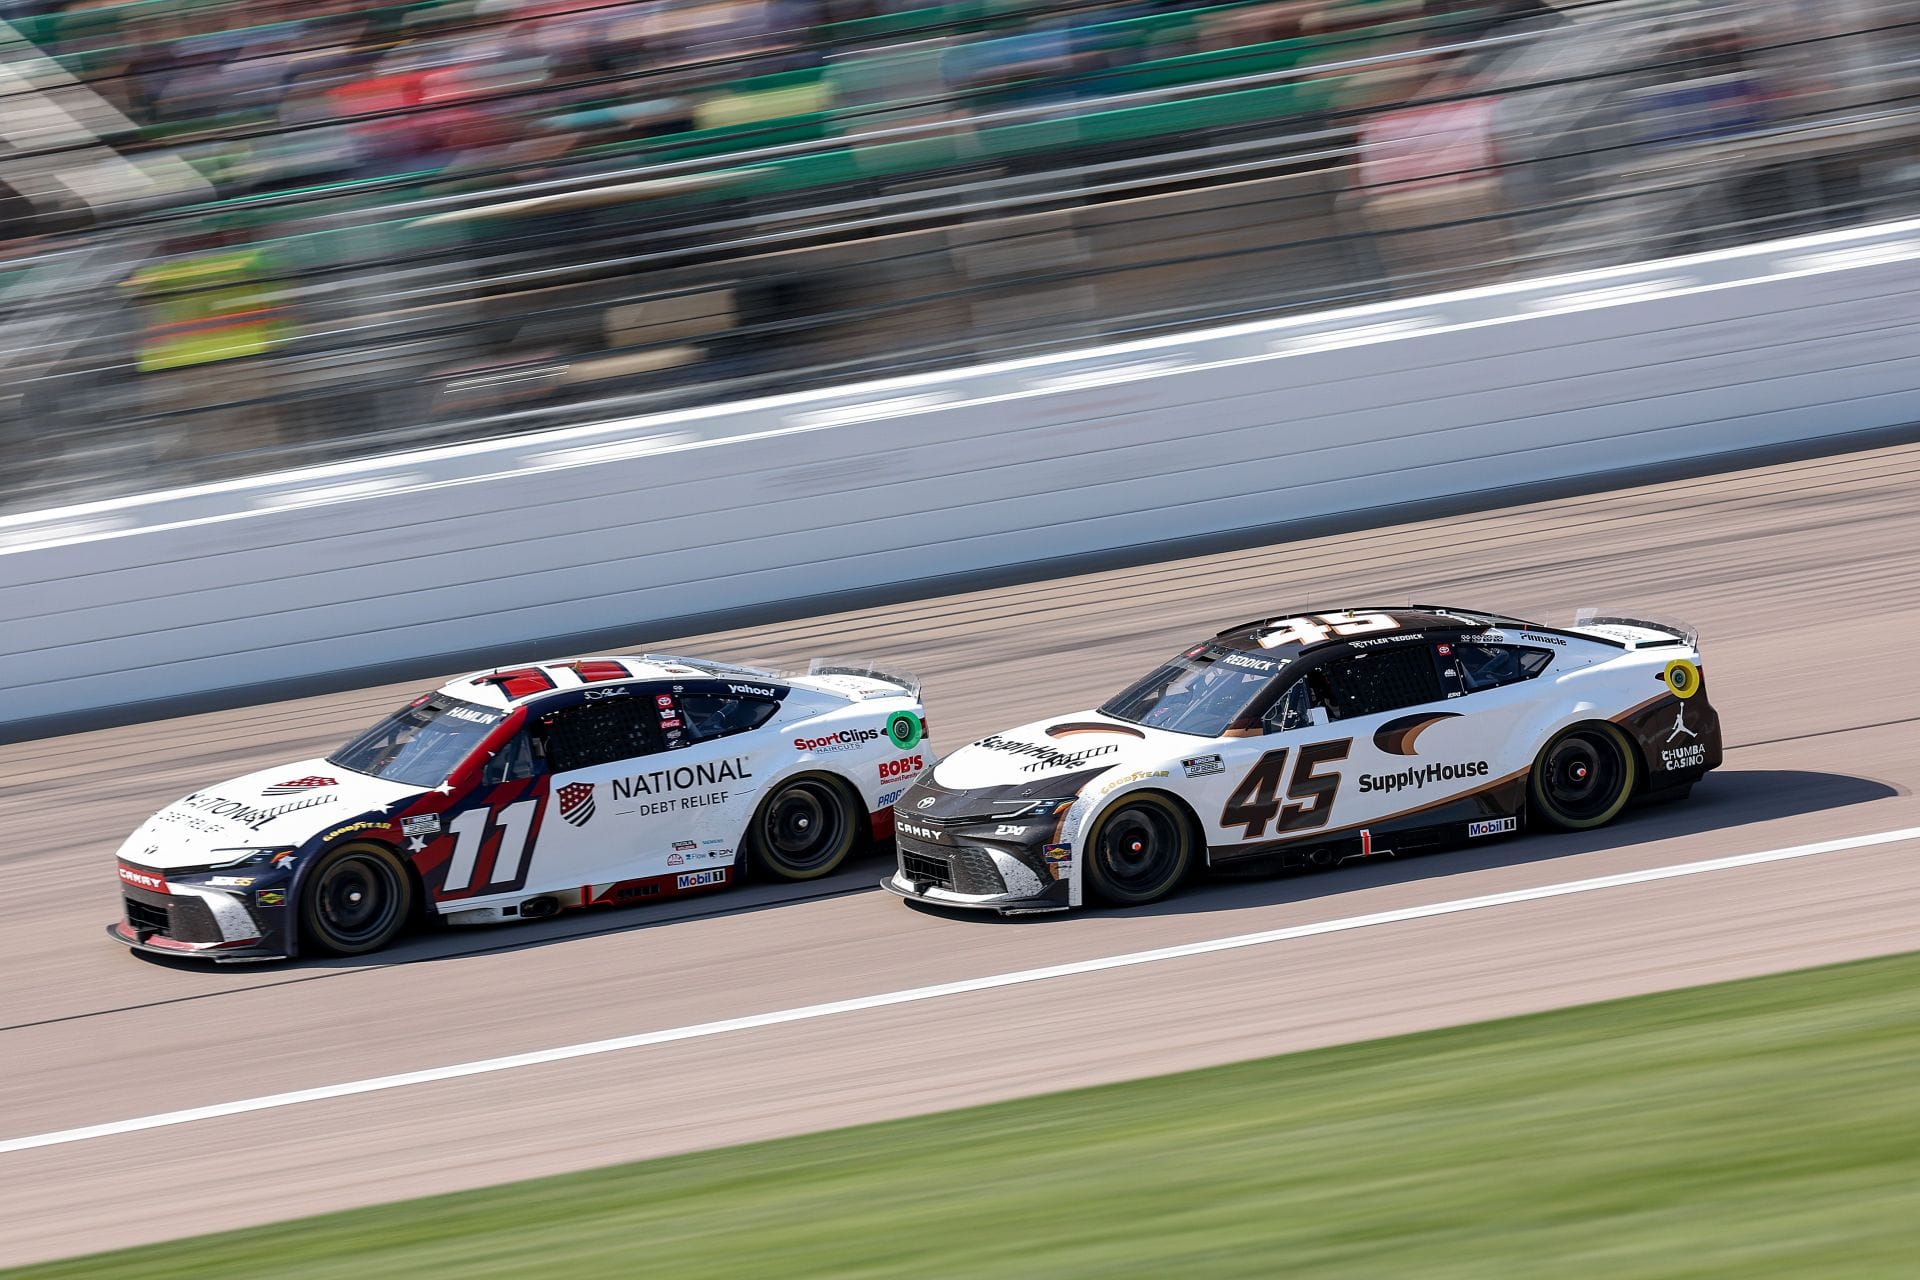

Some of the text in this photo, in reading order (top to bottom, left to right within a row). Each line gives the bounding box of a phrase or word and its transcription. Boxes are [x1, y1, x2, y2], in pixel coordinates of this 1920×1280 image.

[1257, 611, 1401, 650] 45
[1519, 632, 1567, 647] Pinnacle
[1364, 634, 1424, 649] TYLER REDDICK
[1223, 654, 1276, 671] REDDICK
[728, 684, 775, 697] yahoo!
[447, 706, 498, 724] HAMLIN
[794, 729, 878, 751] SportClips
[815, 743, 861, 754] HAIRCUTS
[1662, 743, 1706, 761] CHUMBA
[879, 755, 923, 779] BOB'S
[1666, 755, 1704, 771] CASINO
[612, 758, 752, 801] NATIONAL
[1100, 770, 1170, 796] GOODYEAR
[1358, 759, 1489, 793] SupplyHouse
[1220, 737, 1353, 840] 45
[640, 791, 729, 816] DEBT RELIEF
[322, 821, 392, 842] GOODYEAR
[897, 821, 942, 840] CAMRY
[1469, 817, 1515, 836] Mobil 1
[443, 799, 538, 892] 11
[119, 868, 162, 888] CAMRY
[679, 870, 723, 887] Mobil 1
